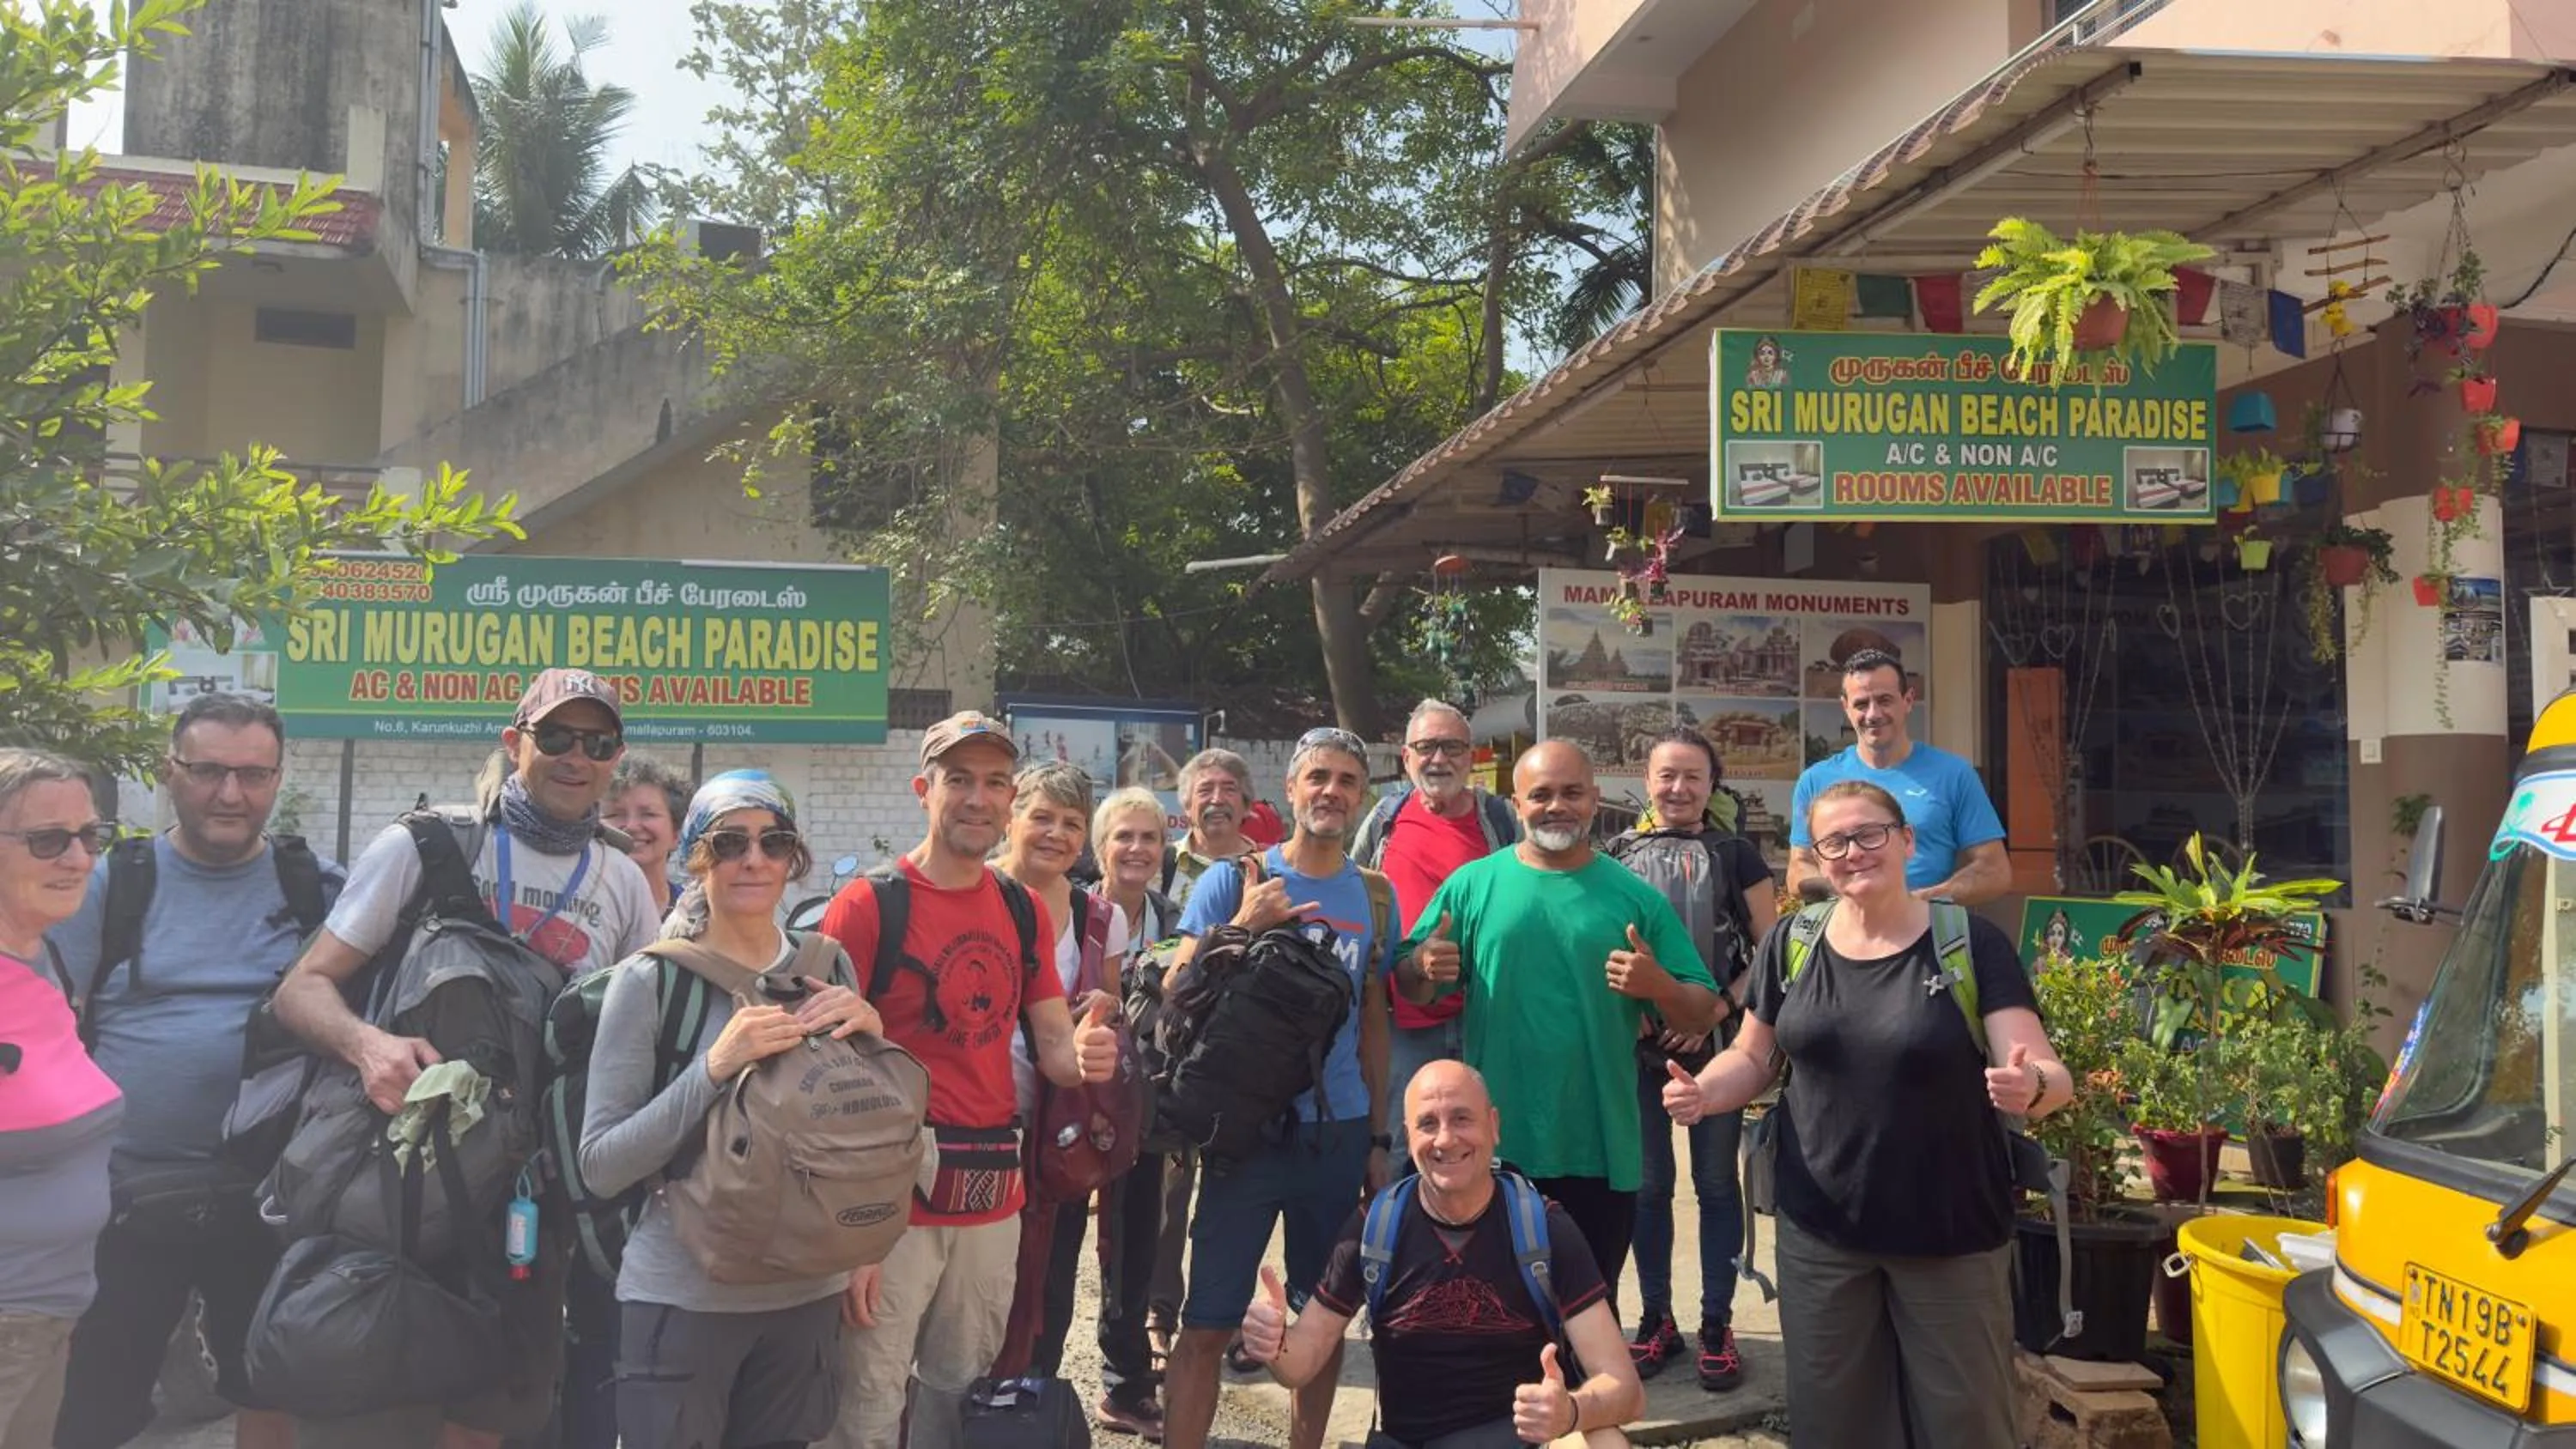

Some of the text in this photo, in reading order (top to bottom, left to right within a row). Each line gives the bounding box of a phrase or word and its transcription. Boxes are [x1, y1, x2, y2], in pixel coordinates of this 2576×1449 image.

[1830, 352, 1949, 385] முருகன்
[1730, 391, 2208, 441] SRI MURUGAN BEACH PARADISE
[1886, 443, 2059, 468] A/C & NON A/C
[1834, 472, 2114, 507] ROOMS AVAILABLE
[517, 580, 630, 608] முருகன்
[1765, 592, 1910, 615] MONUMENTS
[286, 609, 878, 672] SRI MURUGAN BEACH PARADISE
[349, 670, 389, 701] AC
[395, 669, 416, 702] &
[422, 670, 479, 702] NON
[484, 672, 522, 703] AC
[647, 674, 812, 706] AVAILABLE
[2424, 1274, 2512, 1346] TN19B
[2421, 1319, 2512, 1397] T2544
